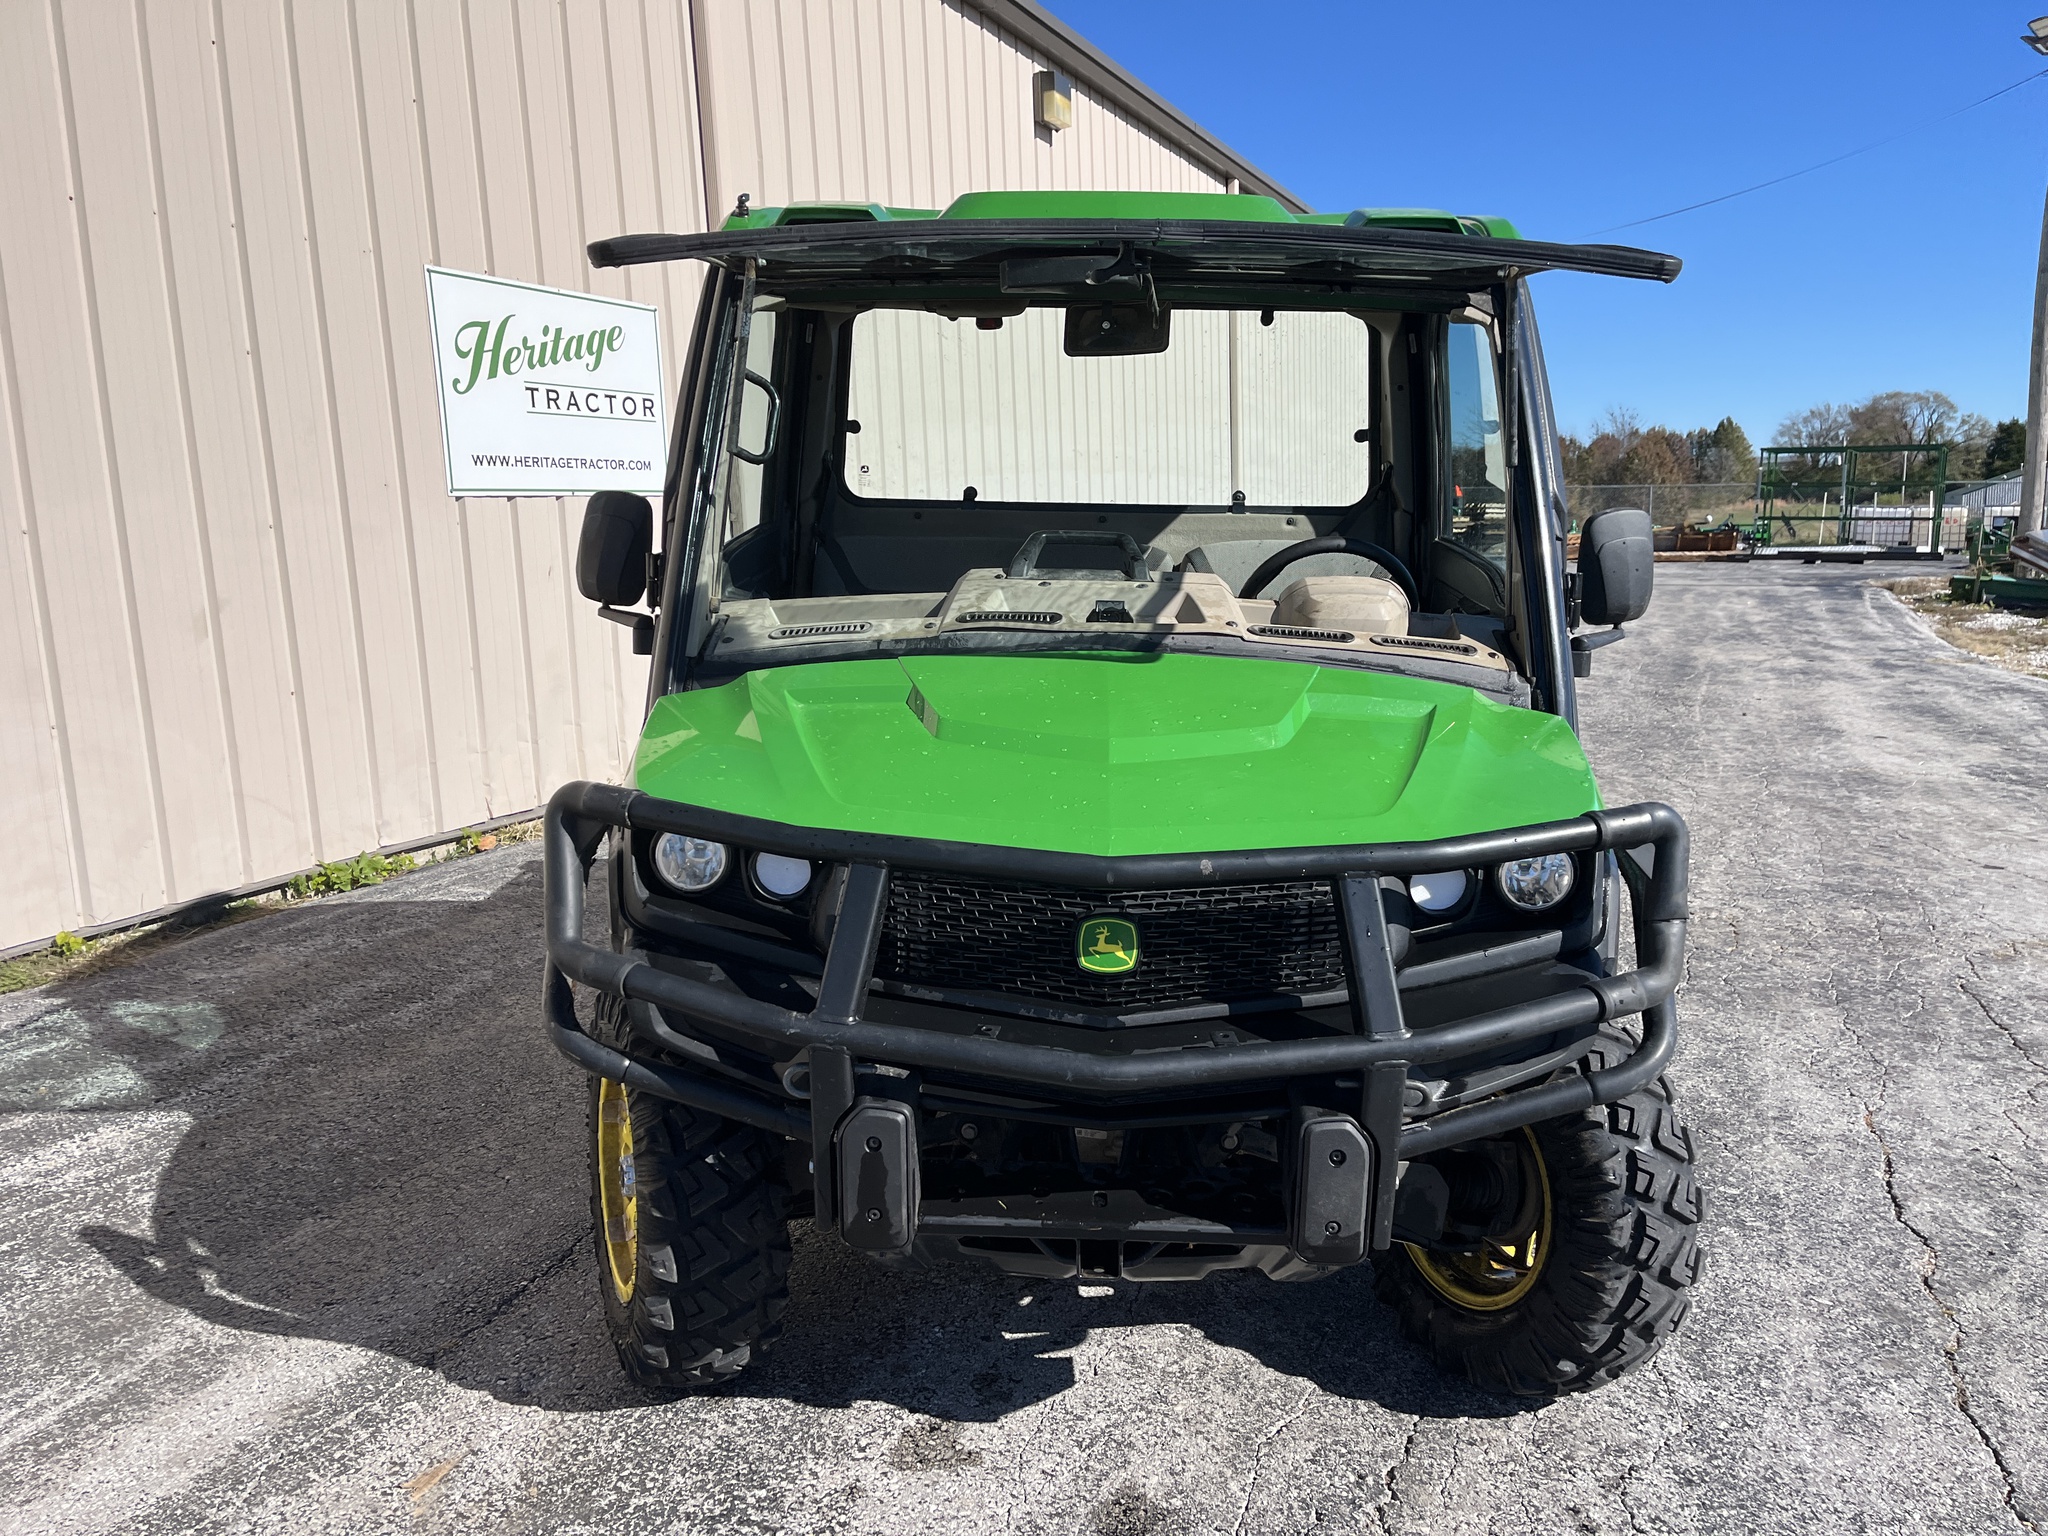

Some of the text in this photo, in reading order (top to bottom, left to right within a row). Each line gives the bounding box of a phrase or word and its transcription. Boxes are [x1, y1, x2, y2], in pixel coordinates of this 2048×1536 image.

[452, 314, 626, 395] Heritage
[525, 386, 655, 417] TRACTOR
[471, 454, 652, 471] WWW.HERITAGETRACTOR.COM
